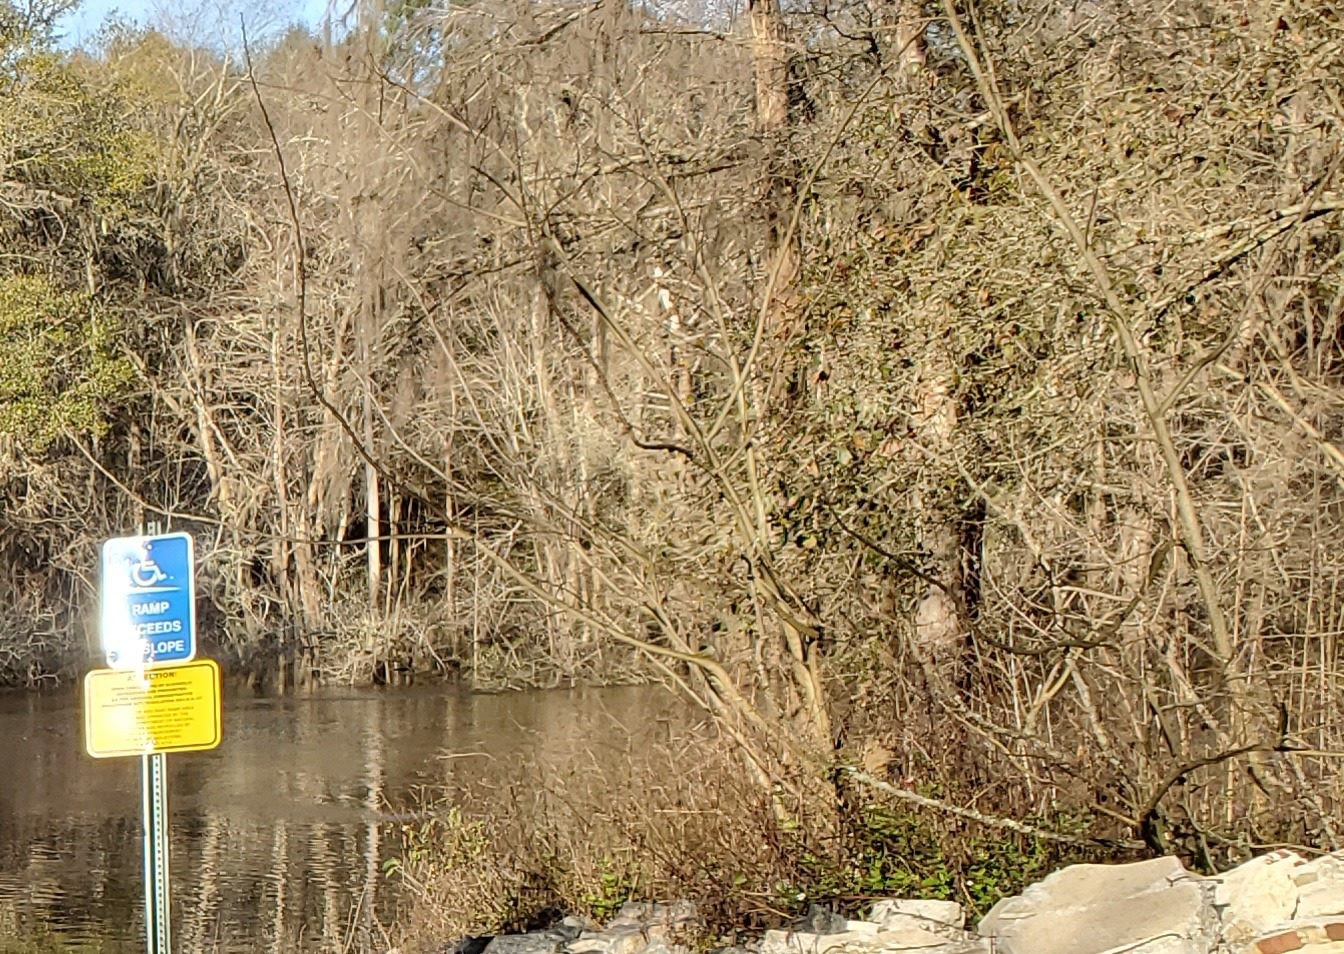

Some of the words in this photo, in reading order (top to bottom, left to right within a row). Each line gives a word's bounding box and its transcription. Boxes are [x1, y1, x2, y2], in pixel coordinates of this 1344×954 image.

[132, 601, 170, 616] RAMP
[134, 620, 182, 635] CEEDS
[143, 640, 185, 655] SLOPE
